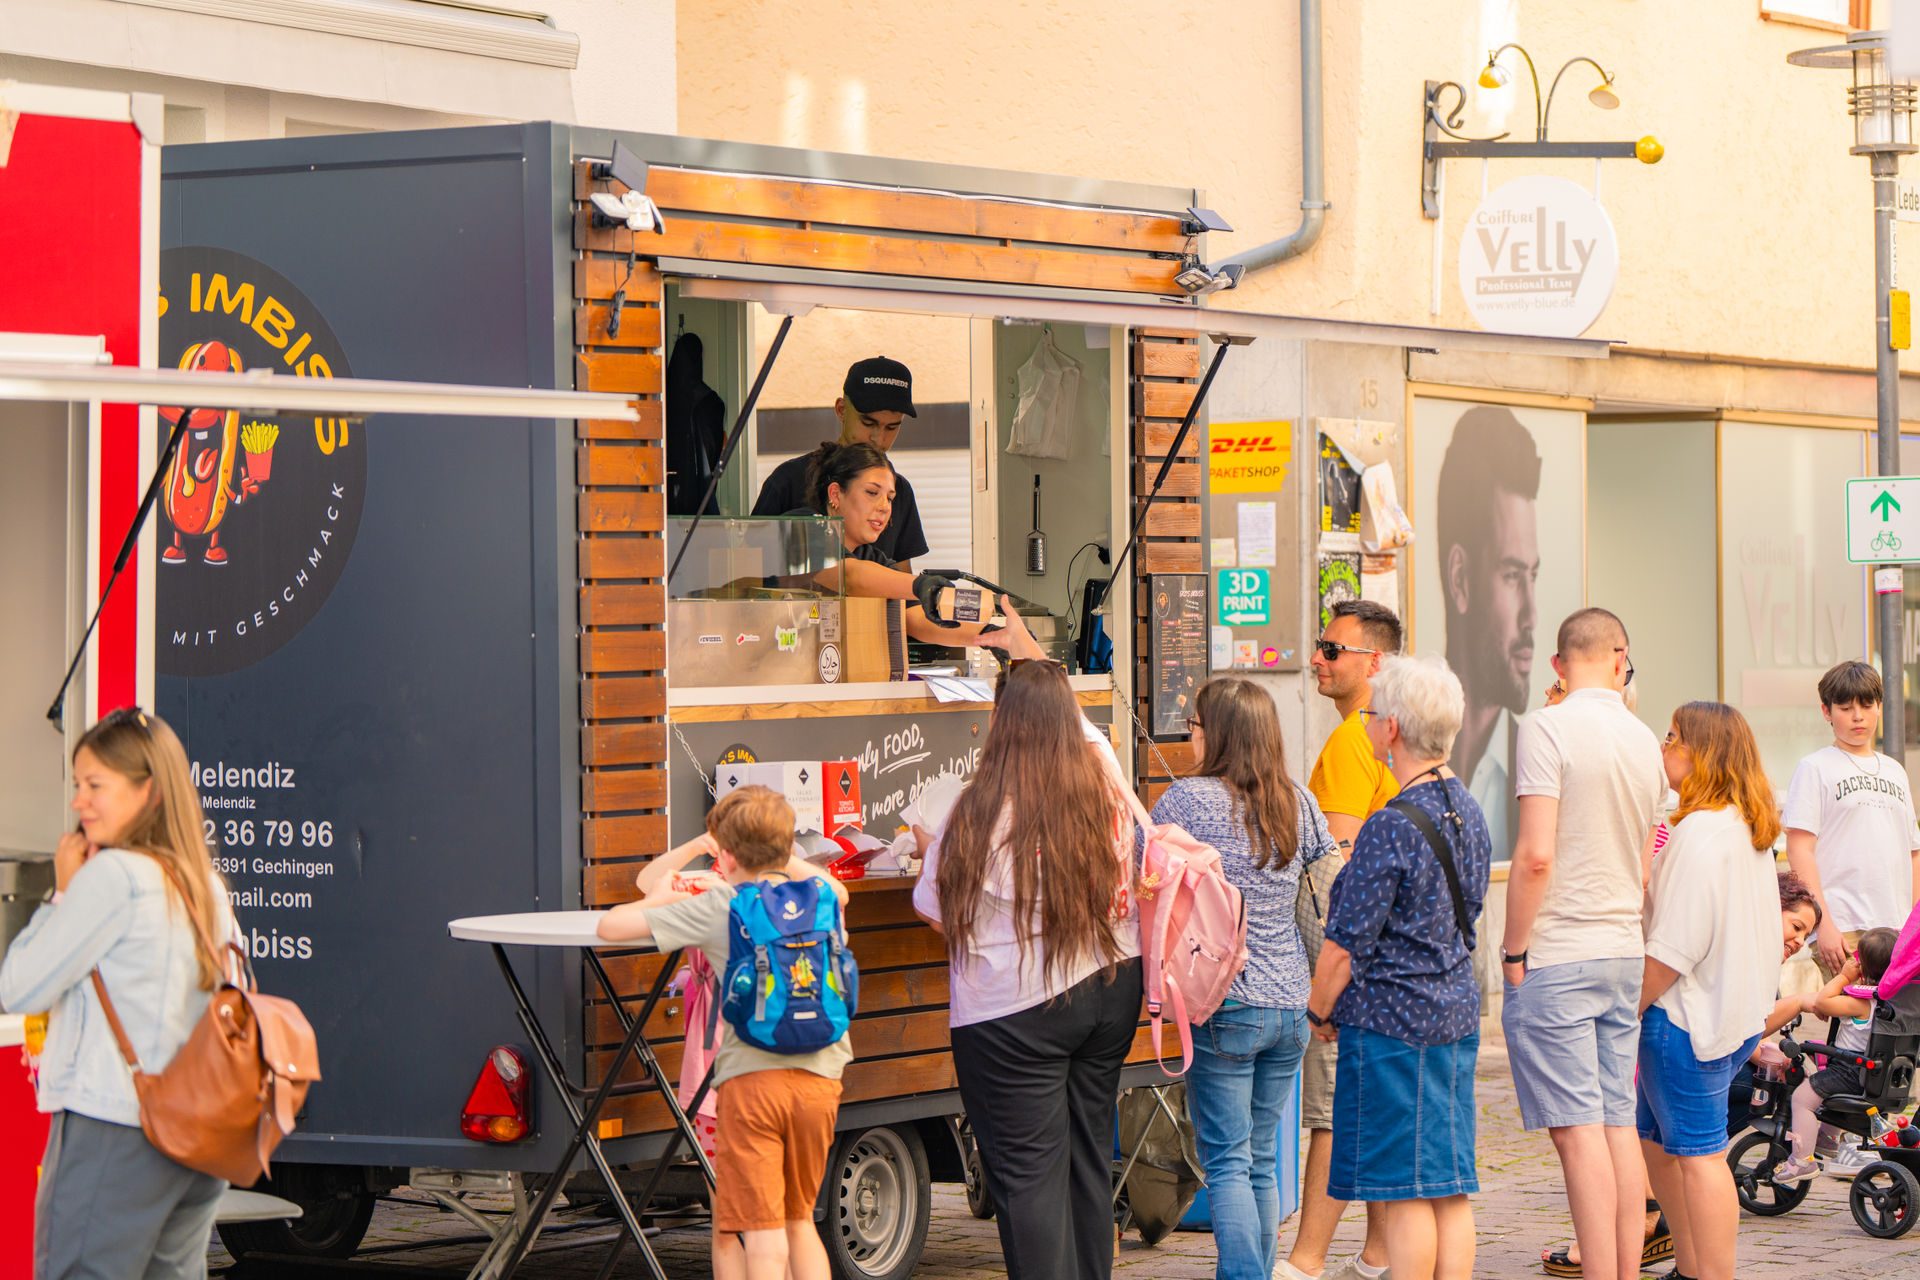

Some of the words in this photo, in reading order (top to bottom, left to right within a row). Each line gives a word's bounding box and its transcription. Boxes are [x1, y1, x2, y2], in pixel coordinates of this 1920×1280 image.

[1898, 185, 1920, 212] Lede
[863, 377, 909, 389] DSQUARED2
[1359, 379, 1379, 408] 15
[1210, 437, 1277, 453] DHL
[1209, 465, 1280, 479] PAKETSHOP
[172, 630, 217, 646] MIT
[236, 482, 345, 636] GESCHMACK
[1228, 572, 1261, 595] 3D
[1222, 595, 1266, 611] PRINT
[852, 741, 879, 779] nly
[883, 723, 925, 760] FOOD,
[1835, 775, 1906, 802] JACK&JONE
[202, 796, 256, 809] Melendiz
[871, 789, 905, 821] more
[224, 819, 255, 847] 36
[263, 820, 293, 847] 79
[301, 821, 333, 848] 96
[209, 857, 247, 873] 5391
[252, 858, 334, 878] Gechingen
